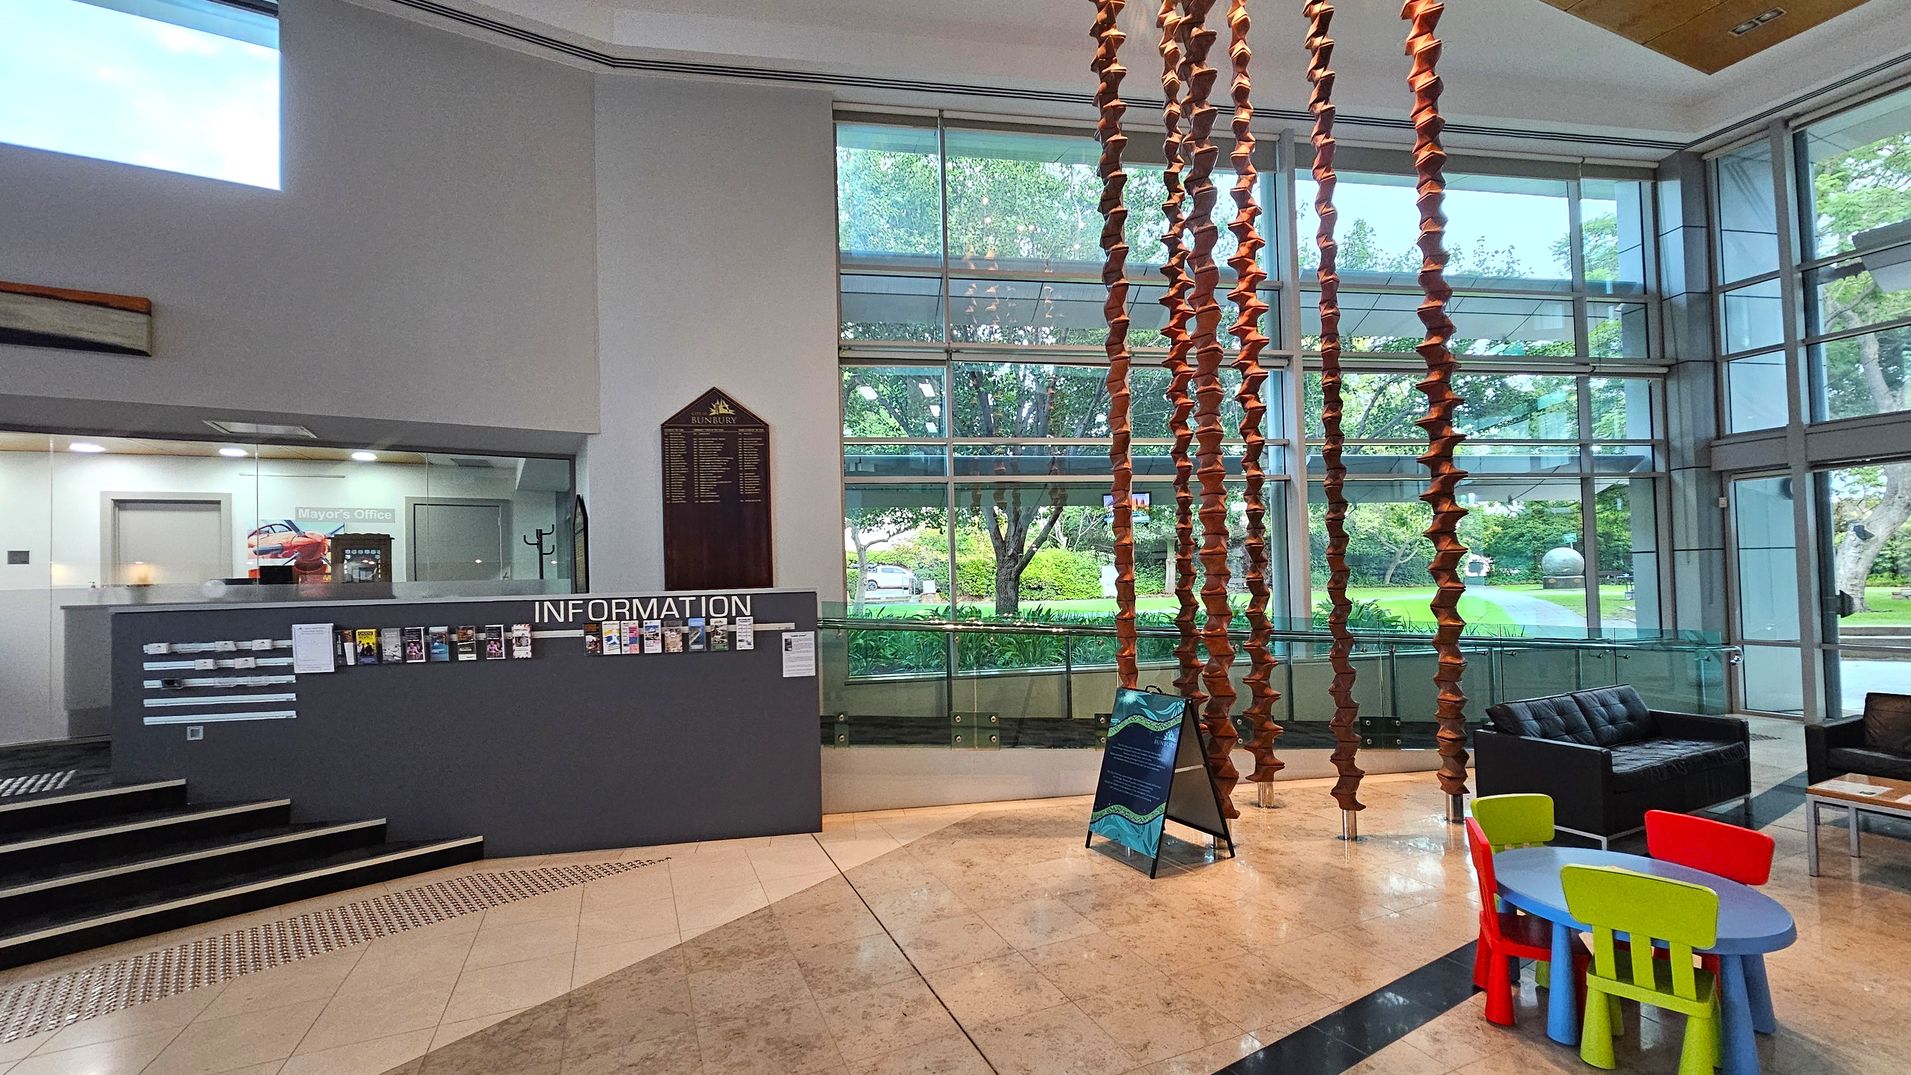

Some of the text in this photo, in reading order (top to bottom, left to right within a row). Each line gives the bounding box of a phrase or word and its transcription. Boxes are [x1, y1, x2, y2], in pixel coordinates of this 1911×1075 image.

[691, 416, 737, 424] BUNBURY
[298, 508, 393, 521] Mayor's Office
[534, 595, 751, 623] INFORMATION
